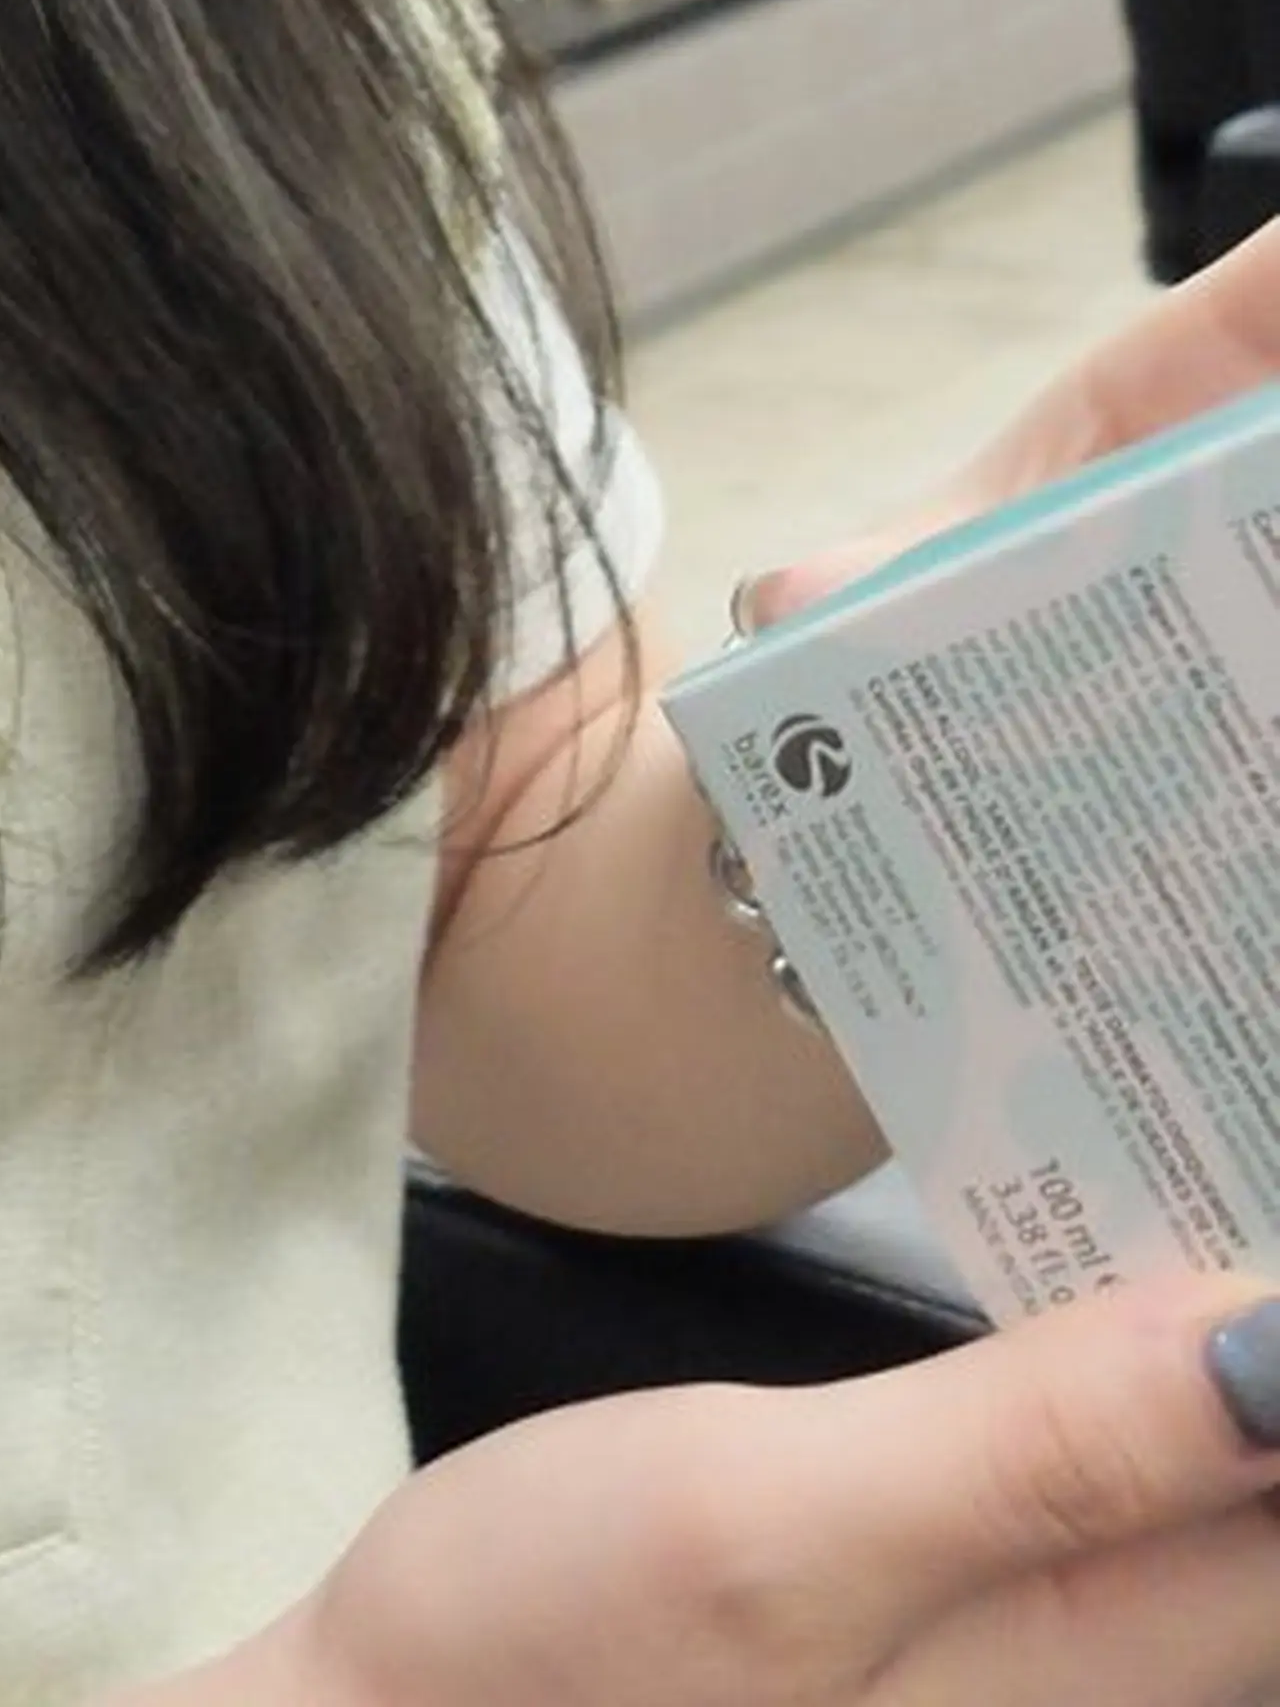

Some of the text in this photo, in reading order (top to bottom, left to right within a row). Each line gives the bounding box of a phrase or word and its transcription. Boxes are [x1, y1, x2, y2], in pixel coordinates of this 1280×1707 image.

[731, 728, 792, 822] barex
[987, 1174, 1050, 1247] 3.38
[1027, 1155, 1115, 1272] 100 ml
